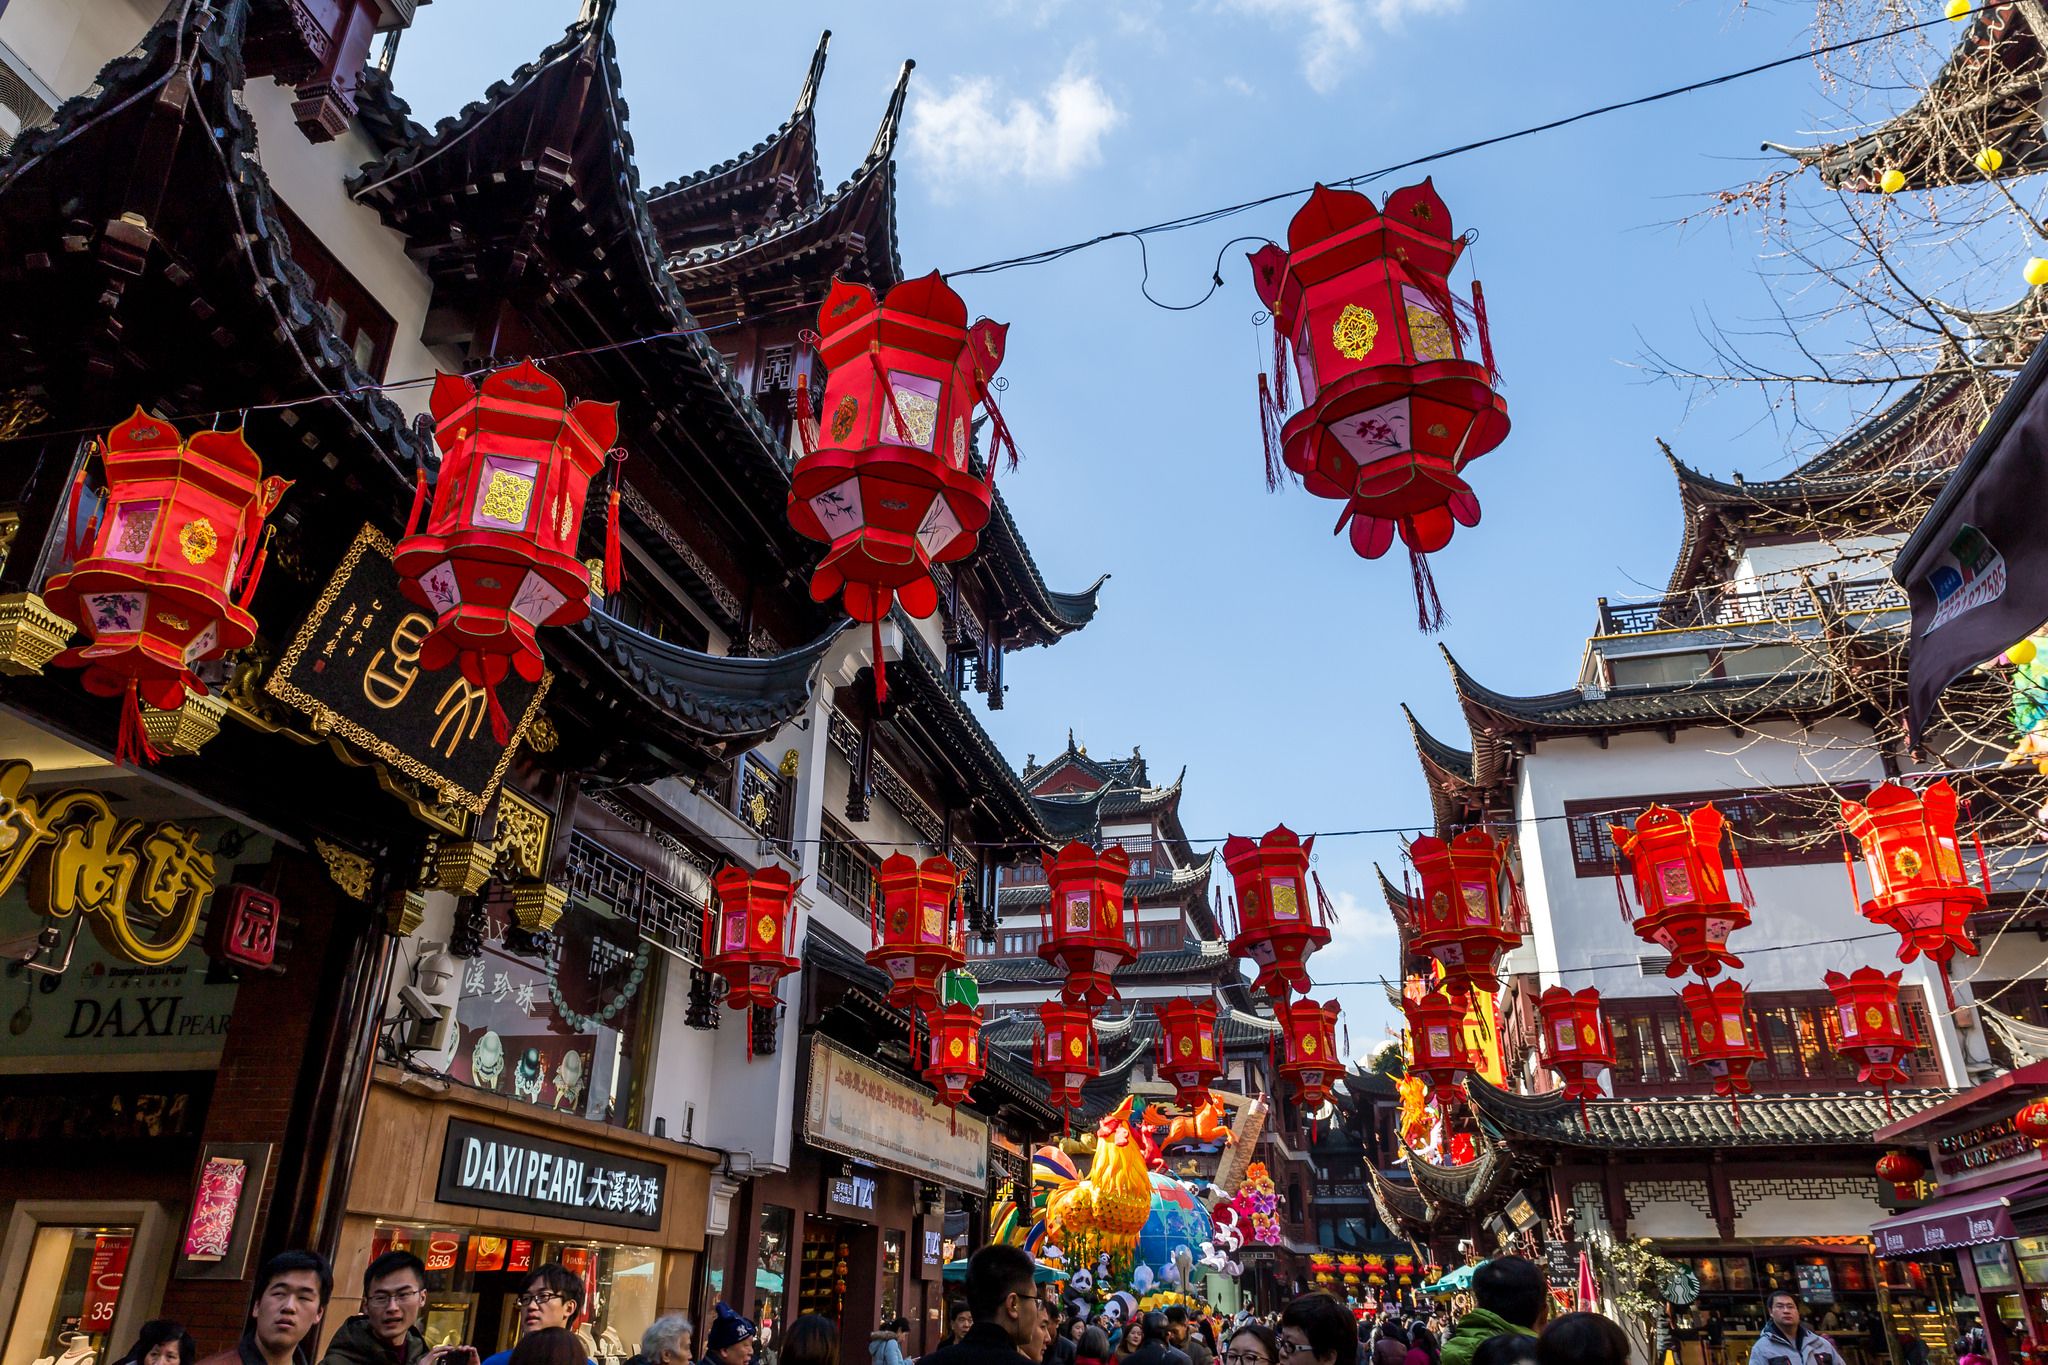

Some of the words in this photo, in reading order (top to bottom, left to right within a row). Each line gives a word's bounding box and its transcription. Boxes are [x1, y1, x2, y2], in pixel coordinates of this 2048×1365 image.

[465, 958, 536, 1015] 溪珍珠
[64, 996, 183, 1038] DAXI
[179, 1014, 232, 1036] PEAR
[463, 1137, 526, 1196] DAXI
[526, 1149, 585, 1205] PEARL
[587, 1167, 658, 1216] 大溪珍珠
[427, 1255, 451, 1267] 358
